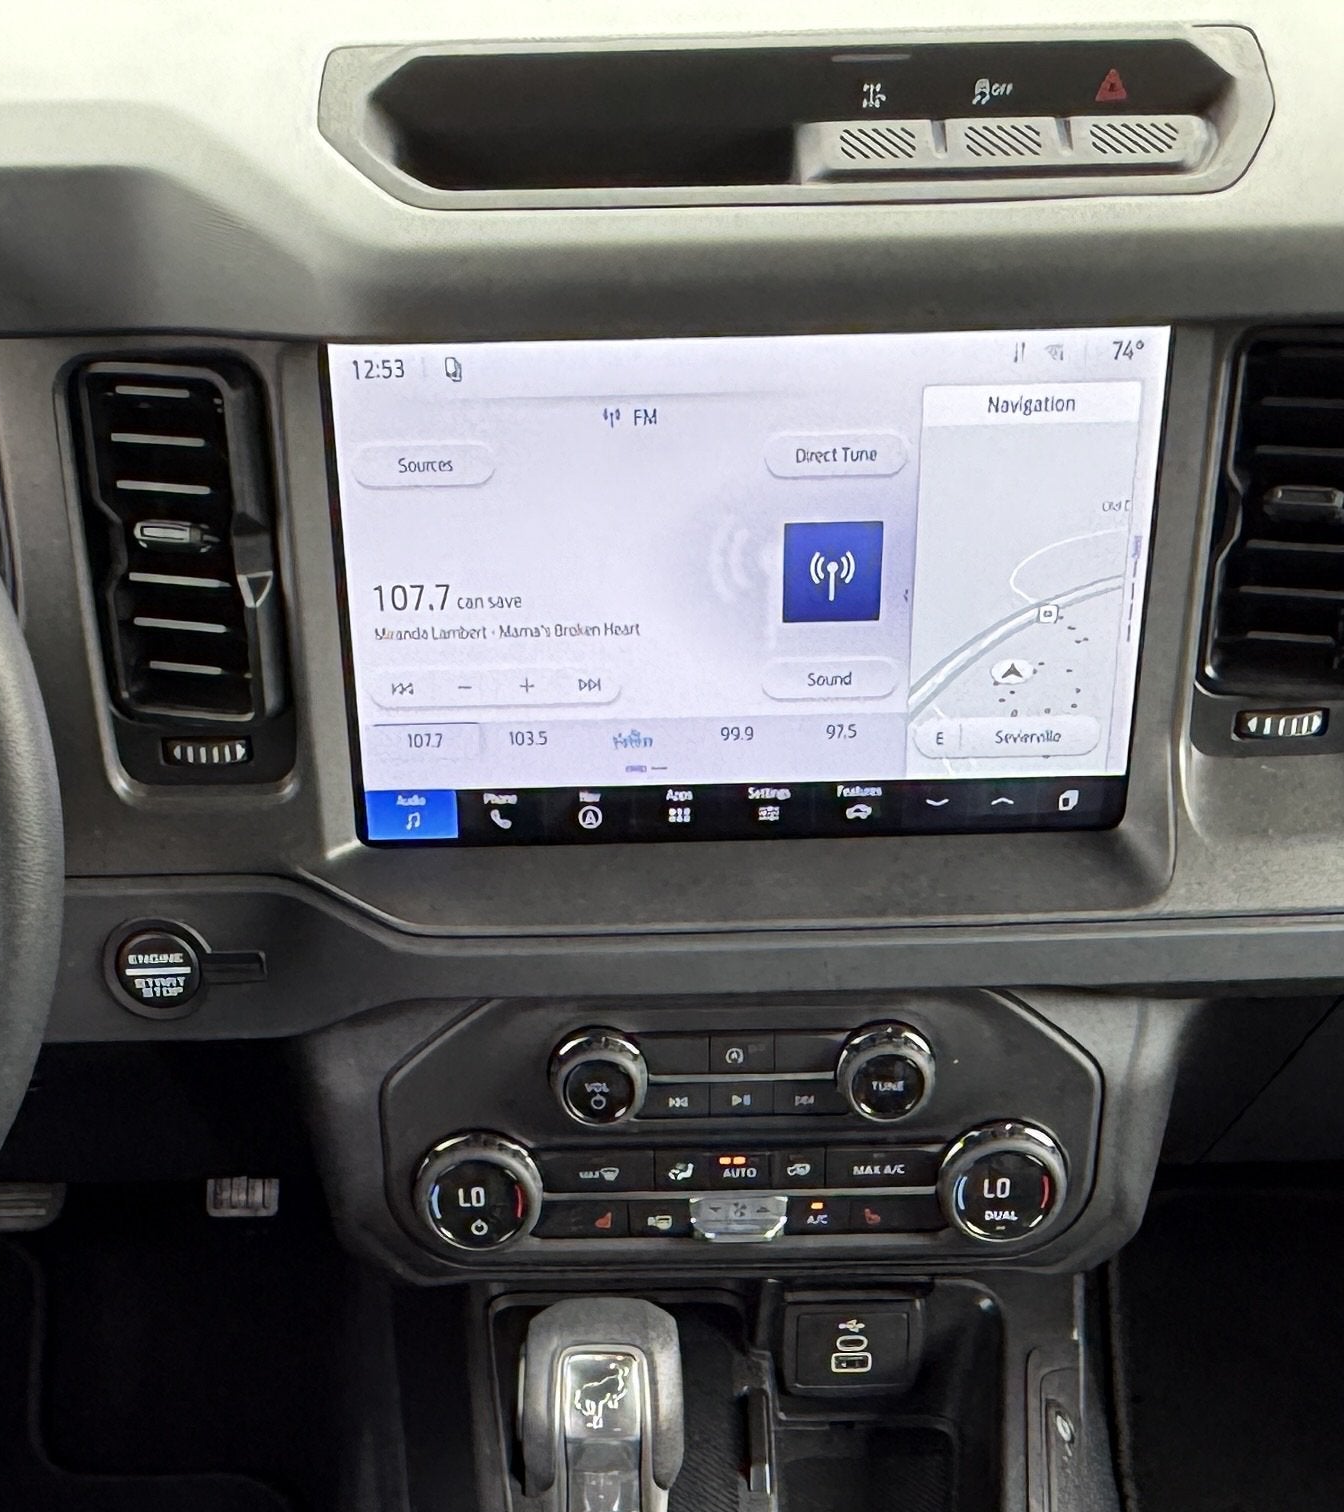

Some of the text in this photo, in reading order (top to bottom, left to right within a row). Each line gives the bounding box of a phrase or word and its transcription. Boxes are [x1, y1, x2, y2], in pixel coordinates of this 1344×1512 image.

[1112, 339, 1145, 362] 74°
[353, 358, 406, 381] 12:53
[988, 394, 1077, 416] Navigation
[633, 409, 658, 426] FM
[795, 446, 879, 465] Direct Tune
[397, 457, 455, 474] Sources
[372, 584, 523, 612] 107.7 can save
[430, 626, 487, 640] Lambert
[603, 621, 641, 637] Heart
[807, 672, 853, 687] Sound
[508, 730, 548, 747] 103.5
[720, 725, 755, 742] 99.9
[825, 723, 858, 740] 97.5
[935, 731, 945, 745] E
[722, 1167, 758, 1179] AUTO
[852, 1164, 906, 1176] MAX A/C
[983, 1210, 1020, 1221] DUAL
